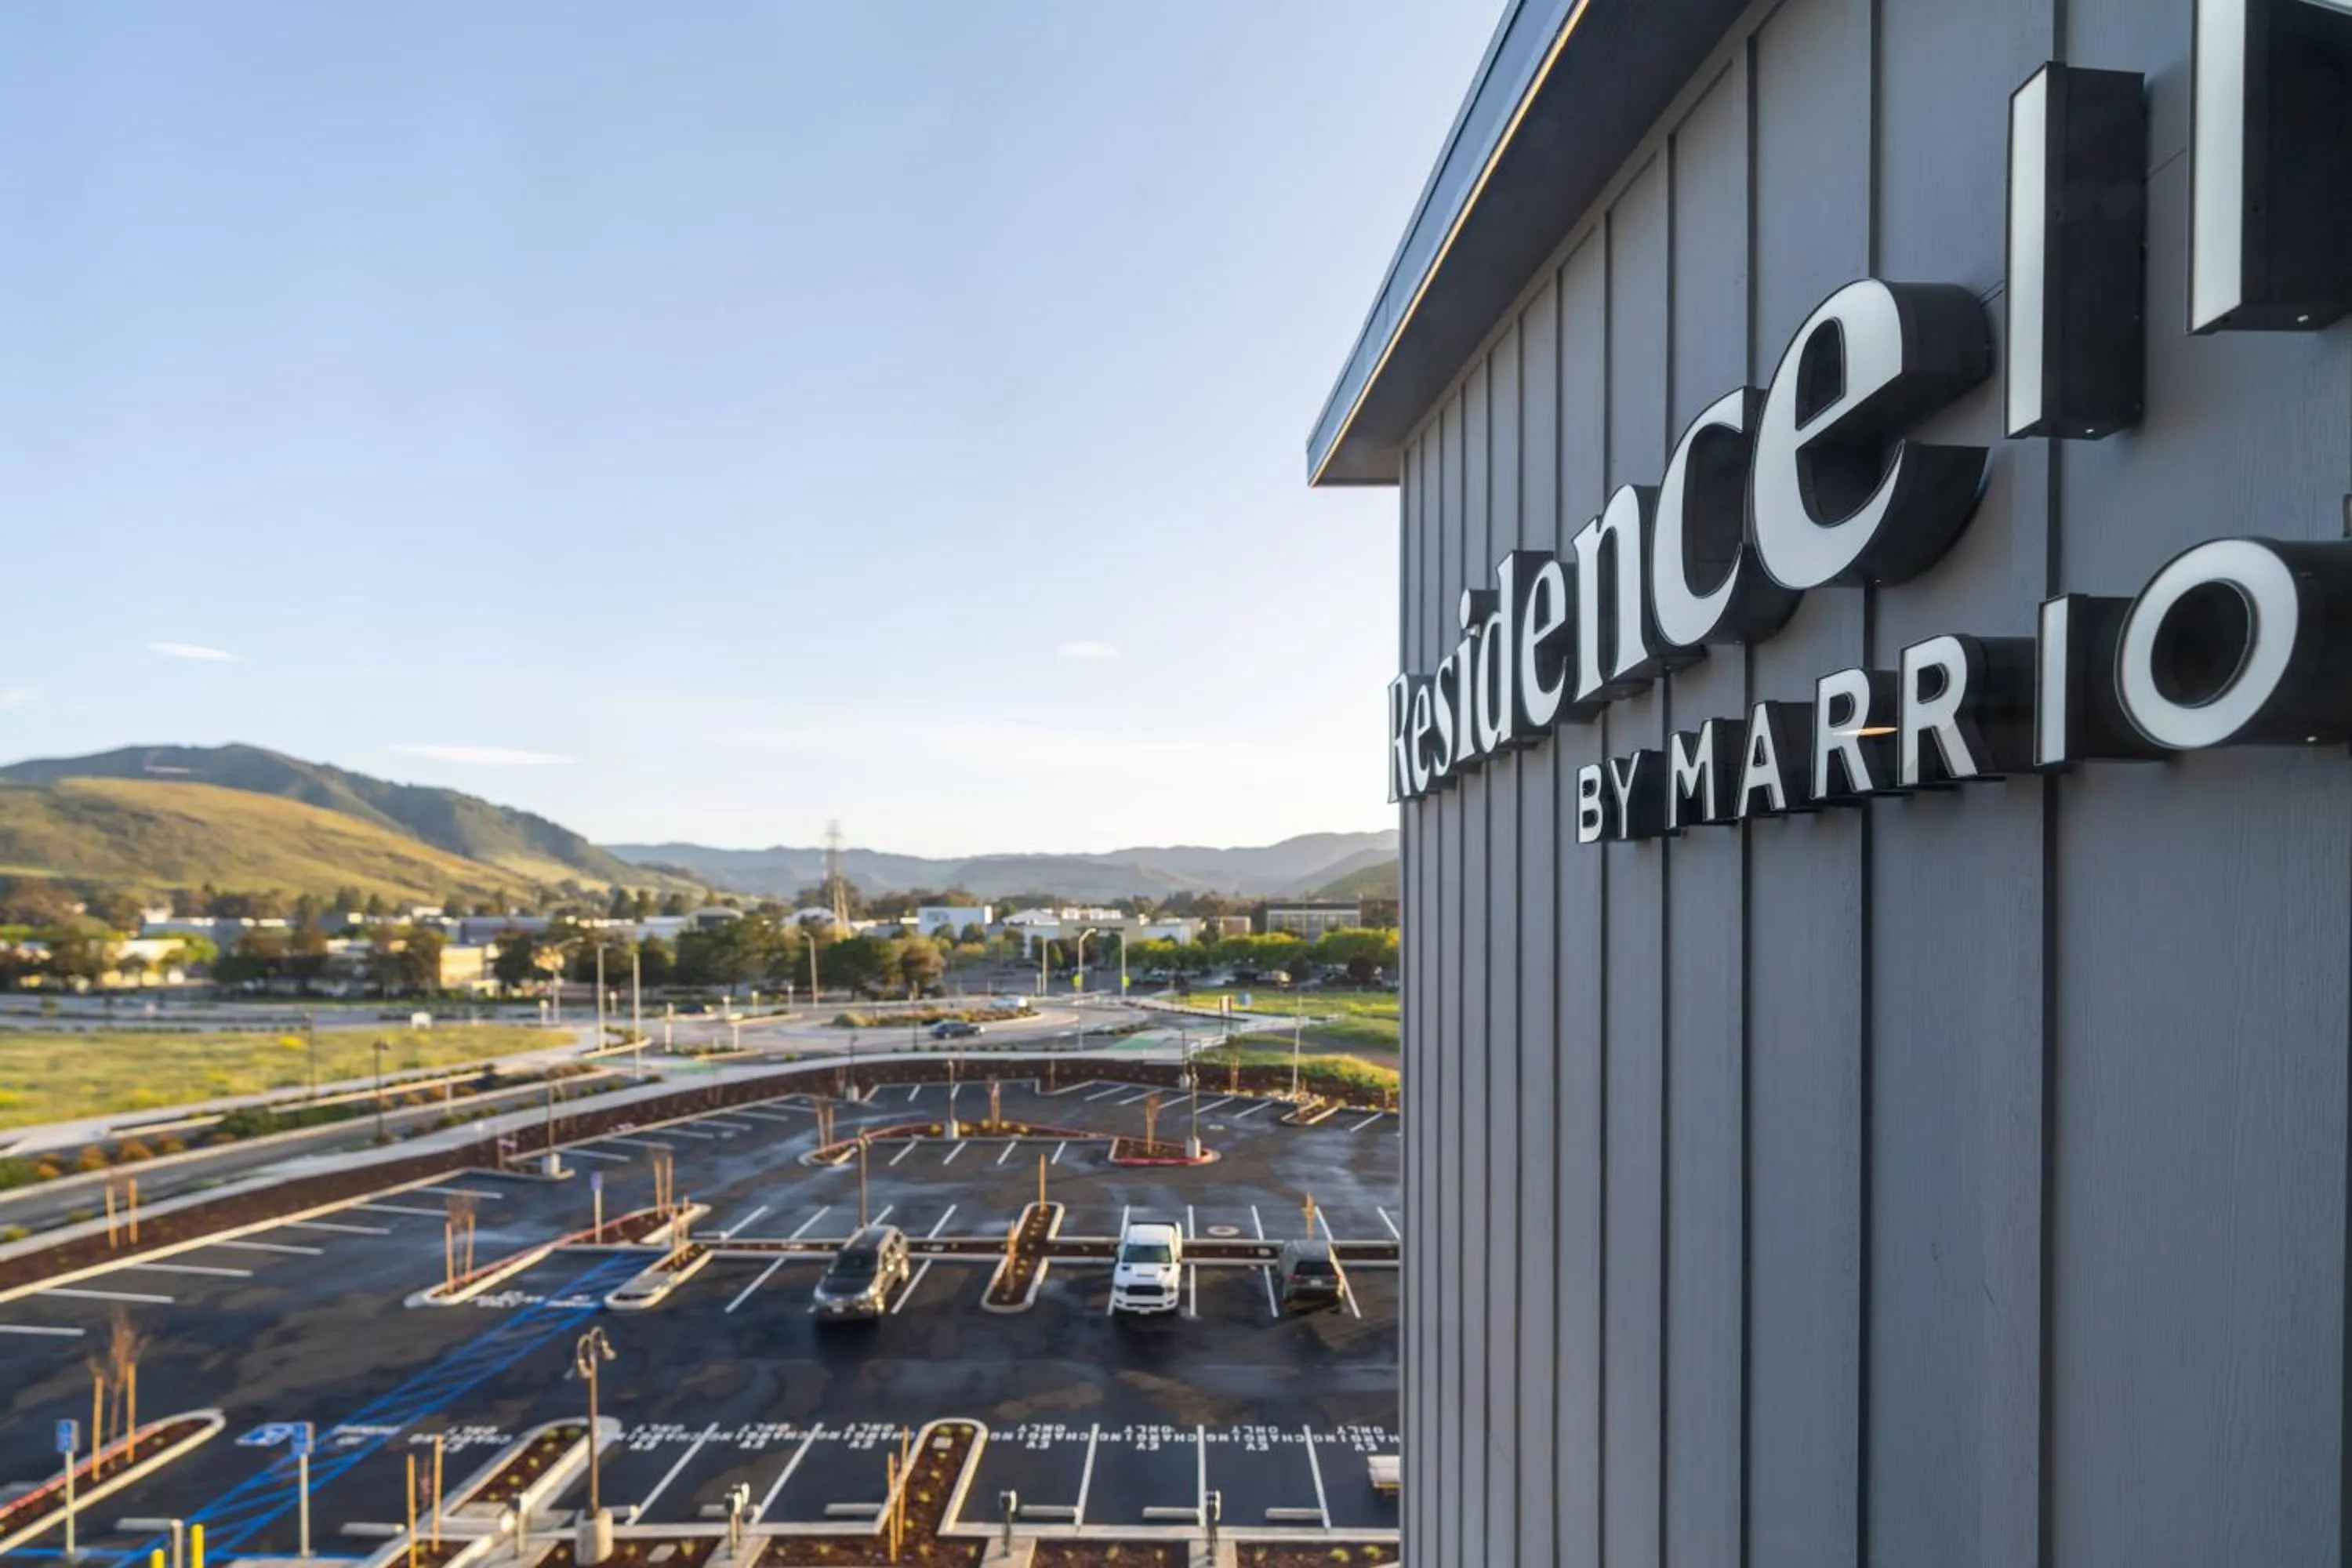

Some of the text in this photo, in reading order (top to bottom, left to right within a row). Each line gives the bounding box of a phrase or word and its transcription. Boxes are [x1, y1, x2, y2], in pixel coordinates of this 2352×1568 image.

[1387, 278, 1904, 803] Residence
[1577, 537, 2300, 844] BY MARRIO
[1017, 1423, 1066, 1433] ONLY
[1123, 1424, 1175, 1433] ONLY
[1231, 1425, 1279, 1434] ONLY
[1336, 1425, 1385, 1435] ONLY
[989, 1432, 1090, 1441] CHARGING
[1099, 1432, 1197, 1443] CHARGING
[1206, 1432, 1305, 1443] CHARGING
[1313, 1432, 1399, 1443] HARGING
[1025, 1440, 1051, 1450] EV
[1136, 1441, 1160, 1450] EV
[1245, 1442, 1269, 1451] EV
[1354, 1442, 1377, 1451] EV
